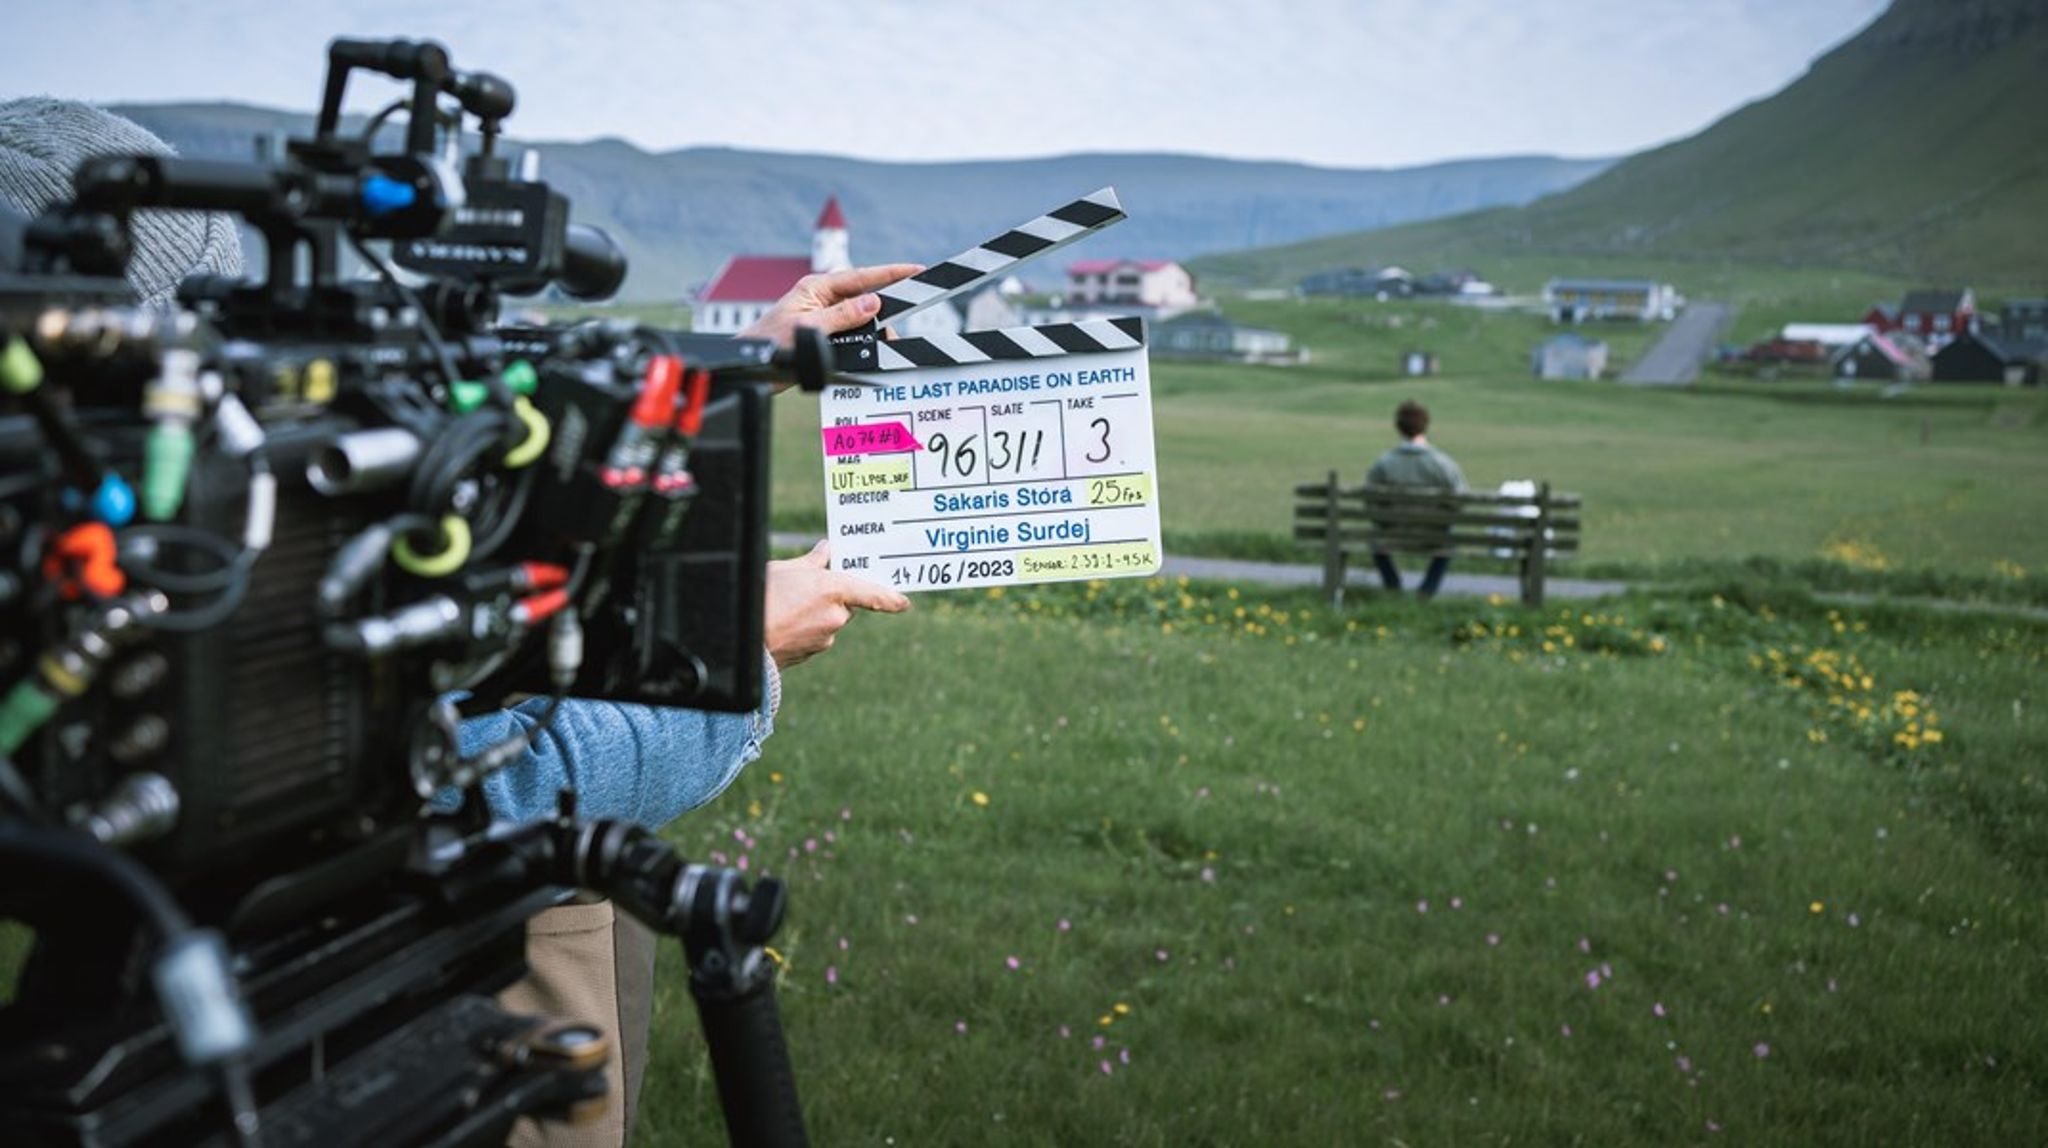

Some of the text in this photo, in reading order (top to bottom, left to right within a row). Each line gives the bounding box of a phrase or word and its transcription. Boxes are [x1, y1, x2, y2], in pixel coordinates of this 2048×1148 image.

[873, 367, 1135, 402] THE LAST PARADISE ON EARTH
[833, 387, 862, 400] PROD
[991, 403, 1024, 416] SLATE
[1067, 397, 1095, 410] TAKE
[917, 409, 952, 422] SCENE
[1085, 417, 1111, 464] 3
[837, 454, 861, 465] MAG
[927, 432, 979, 478] 96
[839, 489, 890, 505] DIRECTOR
[933, 490, 1009, 512] Sakaris
[840, 522, 885, 537] CAMERA
[925, 518, 1091, 552] Virginie Surdej
[841, 556, 870, 570] DATE
